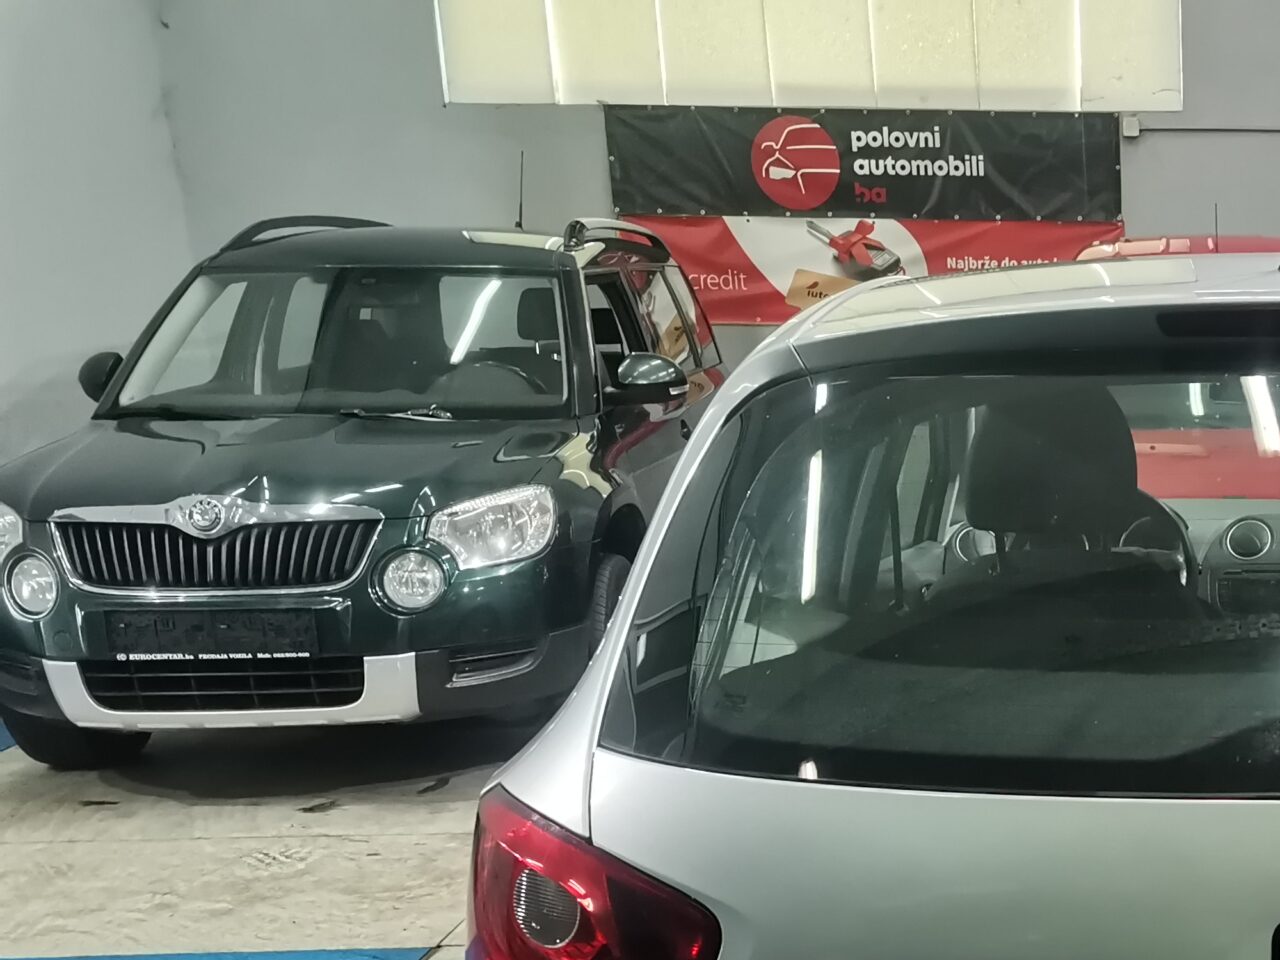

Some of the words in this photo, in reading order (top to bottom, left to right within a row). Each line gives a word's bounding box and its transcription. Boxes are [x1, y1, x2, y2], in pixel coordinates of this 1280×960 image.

[850, 125, 941, 153] polovni
[853, 154, 985, 177] automobili
[946, 255, 999, 272] Najbrže
